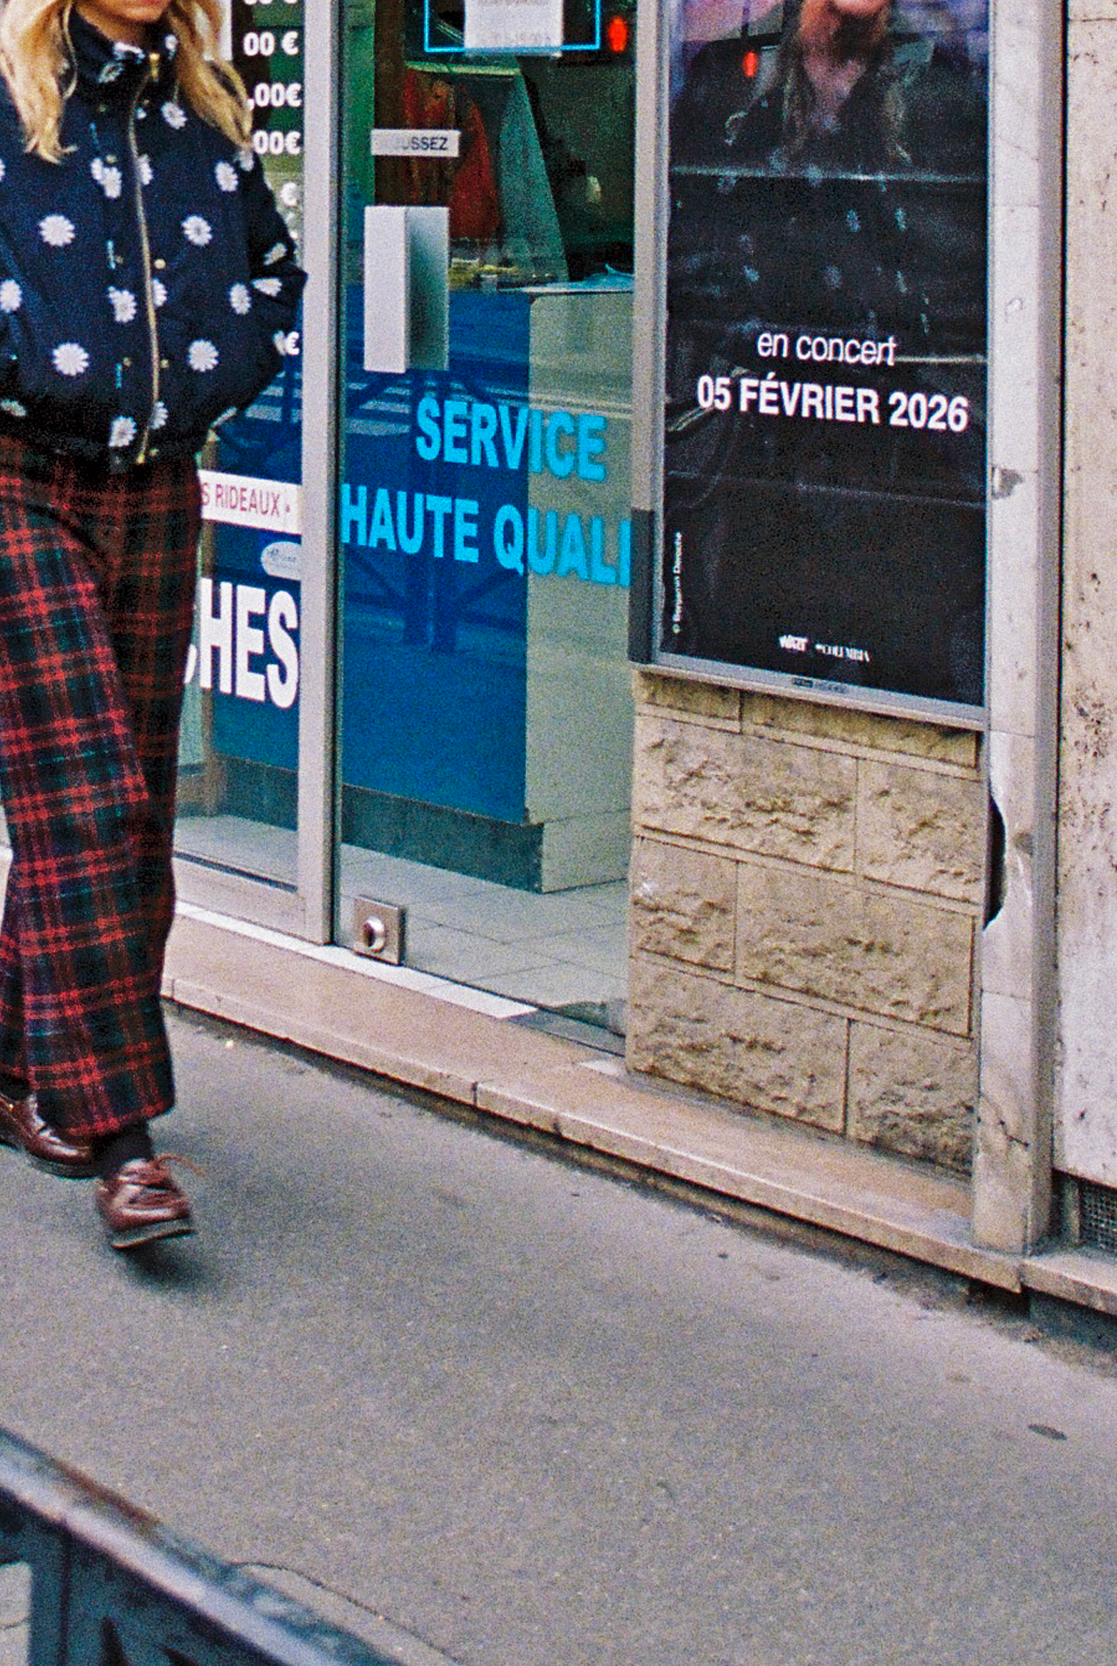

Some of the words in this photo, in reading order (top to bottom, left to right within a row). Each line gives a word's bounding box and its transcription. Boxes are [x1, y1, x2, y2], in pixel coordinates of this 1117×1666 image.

[757, 332, 788, 358] en
[795, 335, 897, 366] concert
[697, 374, 732, 412] 05
[739, 371, 881, 424] FÉVRIER
[888, 391, 969, 433] 2026
[416, 396, 606, 481] SERVICE
[215, 483, 281, 518] RIDEAUX
[341, 484, 480, 563] HAUTE
[184, 577, 299, 709] HES
